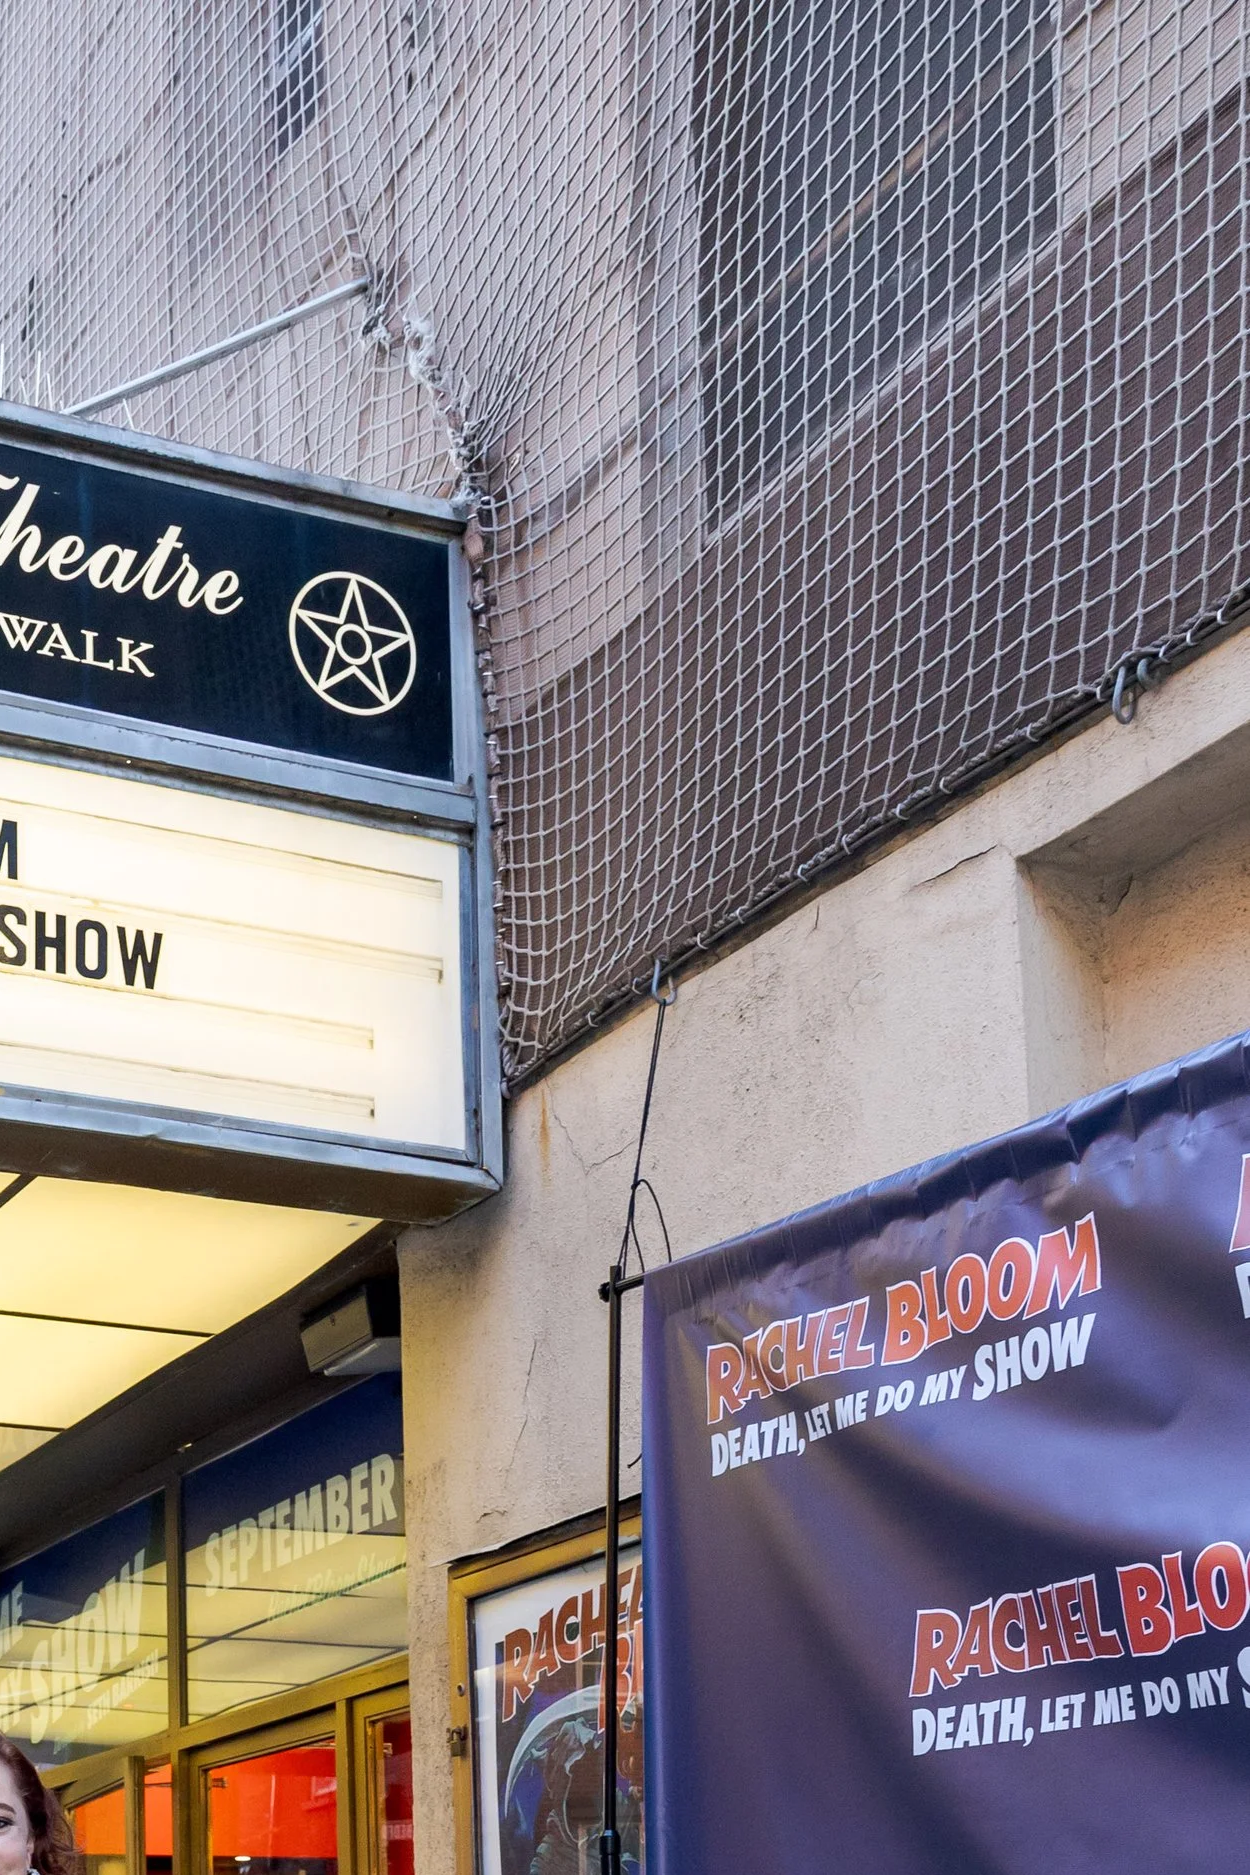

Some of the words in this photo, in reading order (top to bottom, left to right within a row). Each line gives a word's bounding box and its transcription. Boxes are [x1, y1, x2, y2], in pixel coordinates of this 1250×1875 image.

[706, 1297, 874, 1425] RACHEL
[881, 1211, 1102, 1367] BLOOM
[711, 1412, 805, 1477] DEATH,
[804, 1401, 833, 1442] LET
[834, 1389, 867, 1430] ME
[875, 1377, 914, 1418] DO
[919, 1364, 967, 1405] MY
[972, 1312, 1096, 1401] SHOW
[205, 1453, 397, 1598] SEPTEMBER
[30, 1547, 145, 1744] SHOW
[908, 1573, 1124, 1698] RACHEL
[1116, 1541, 1250, 1657] BLO
[912, 1696, 1035, 1756] DEATH,
[1040, 1692, 1082, 1733] LET
[1093, 1684, 1136, 1726] ME
[1141, 1676, 1181, 1717] DO
[1186, 1666, 1230, 1709] MY
